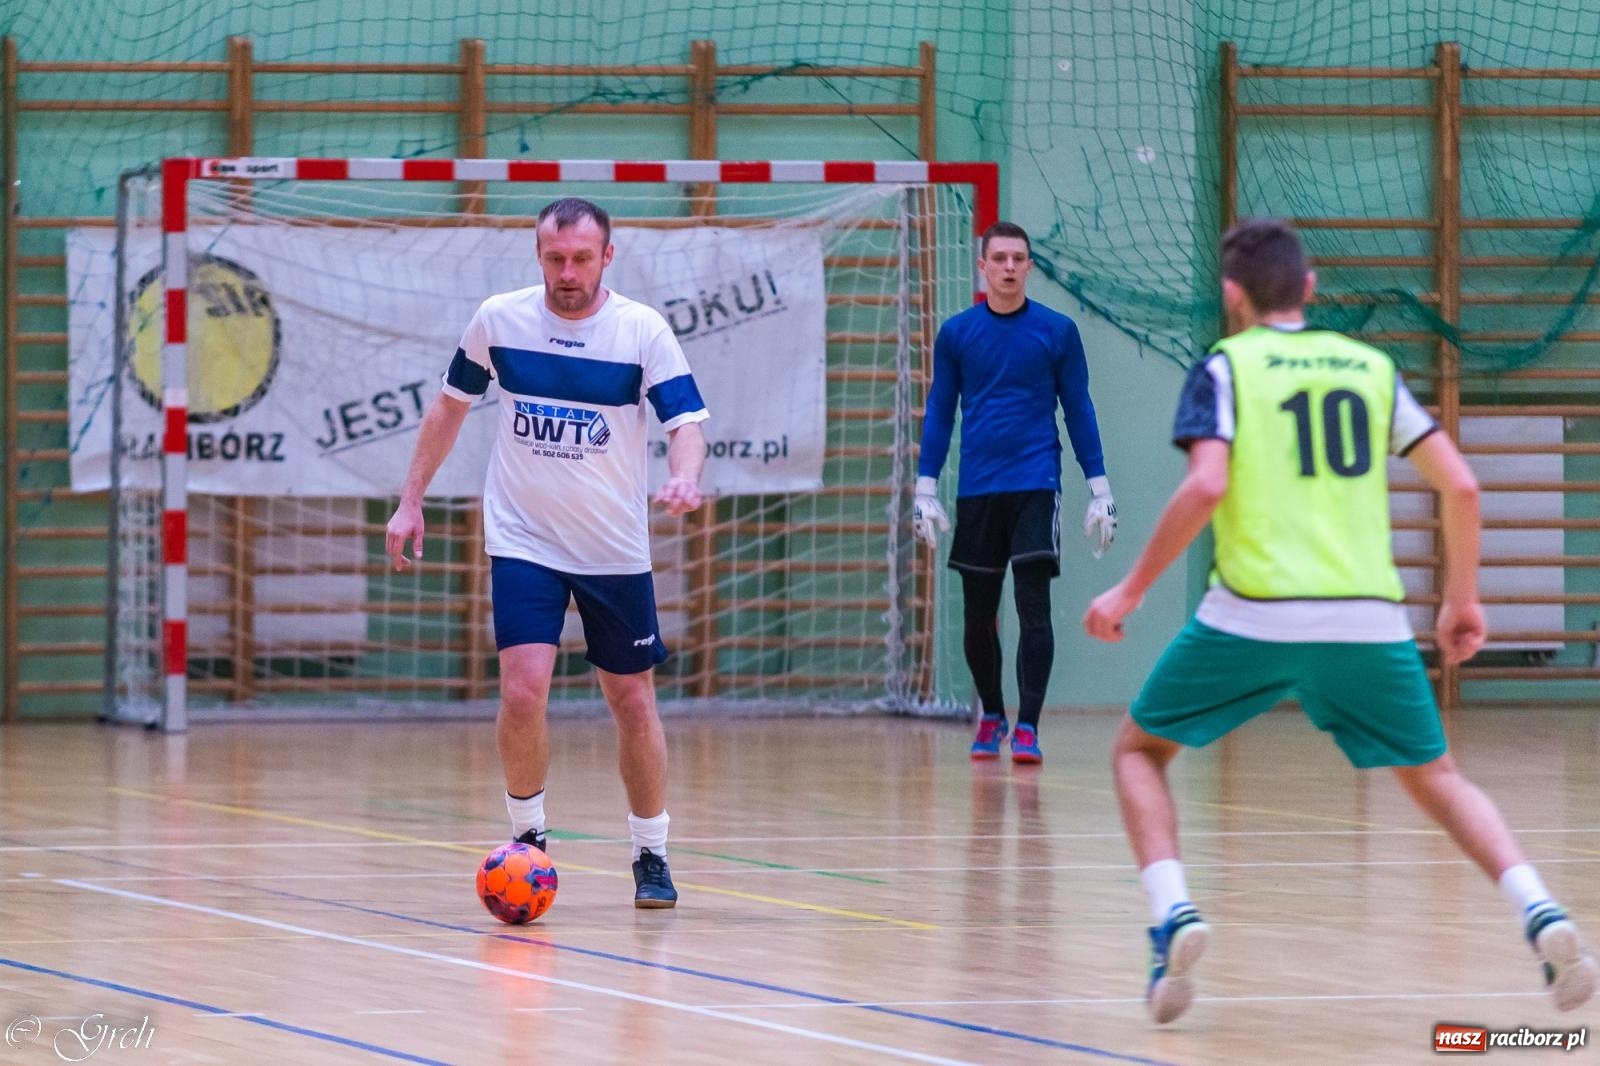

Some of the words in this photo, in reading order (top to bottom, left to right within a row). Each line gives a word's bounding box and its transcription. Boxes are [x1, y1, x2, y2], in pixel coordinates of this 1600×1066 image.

[316, 379, 427, 448] JEST
[513, 411, 589, 445] DWT
[1279, 388, 1371, 477] 10
